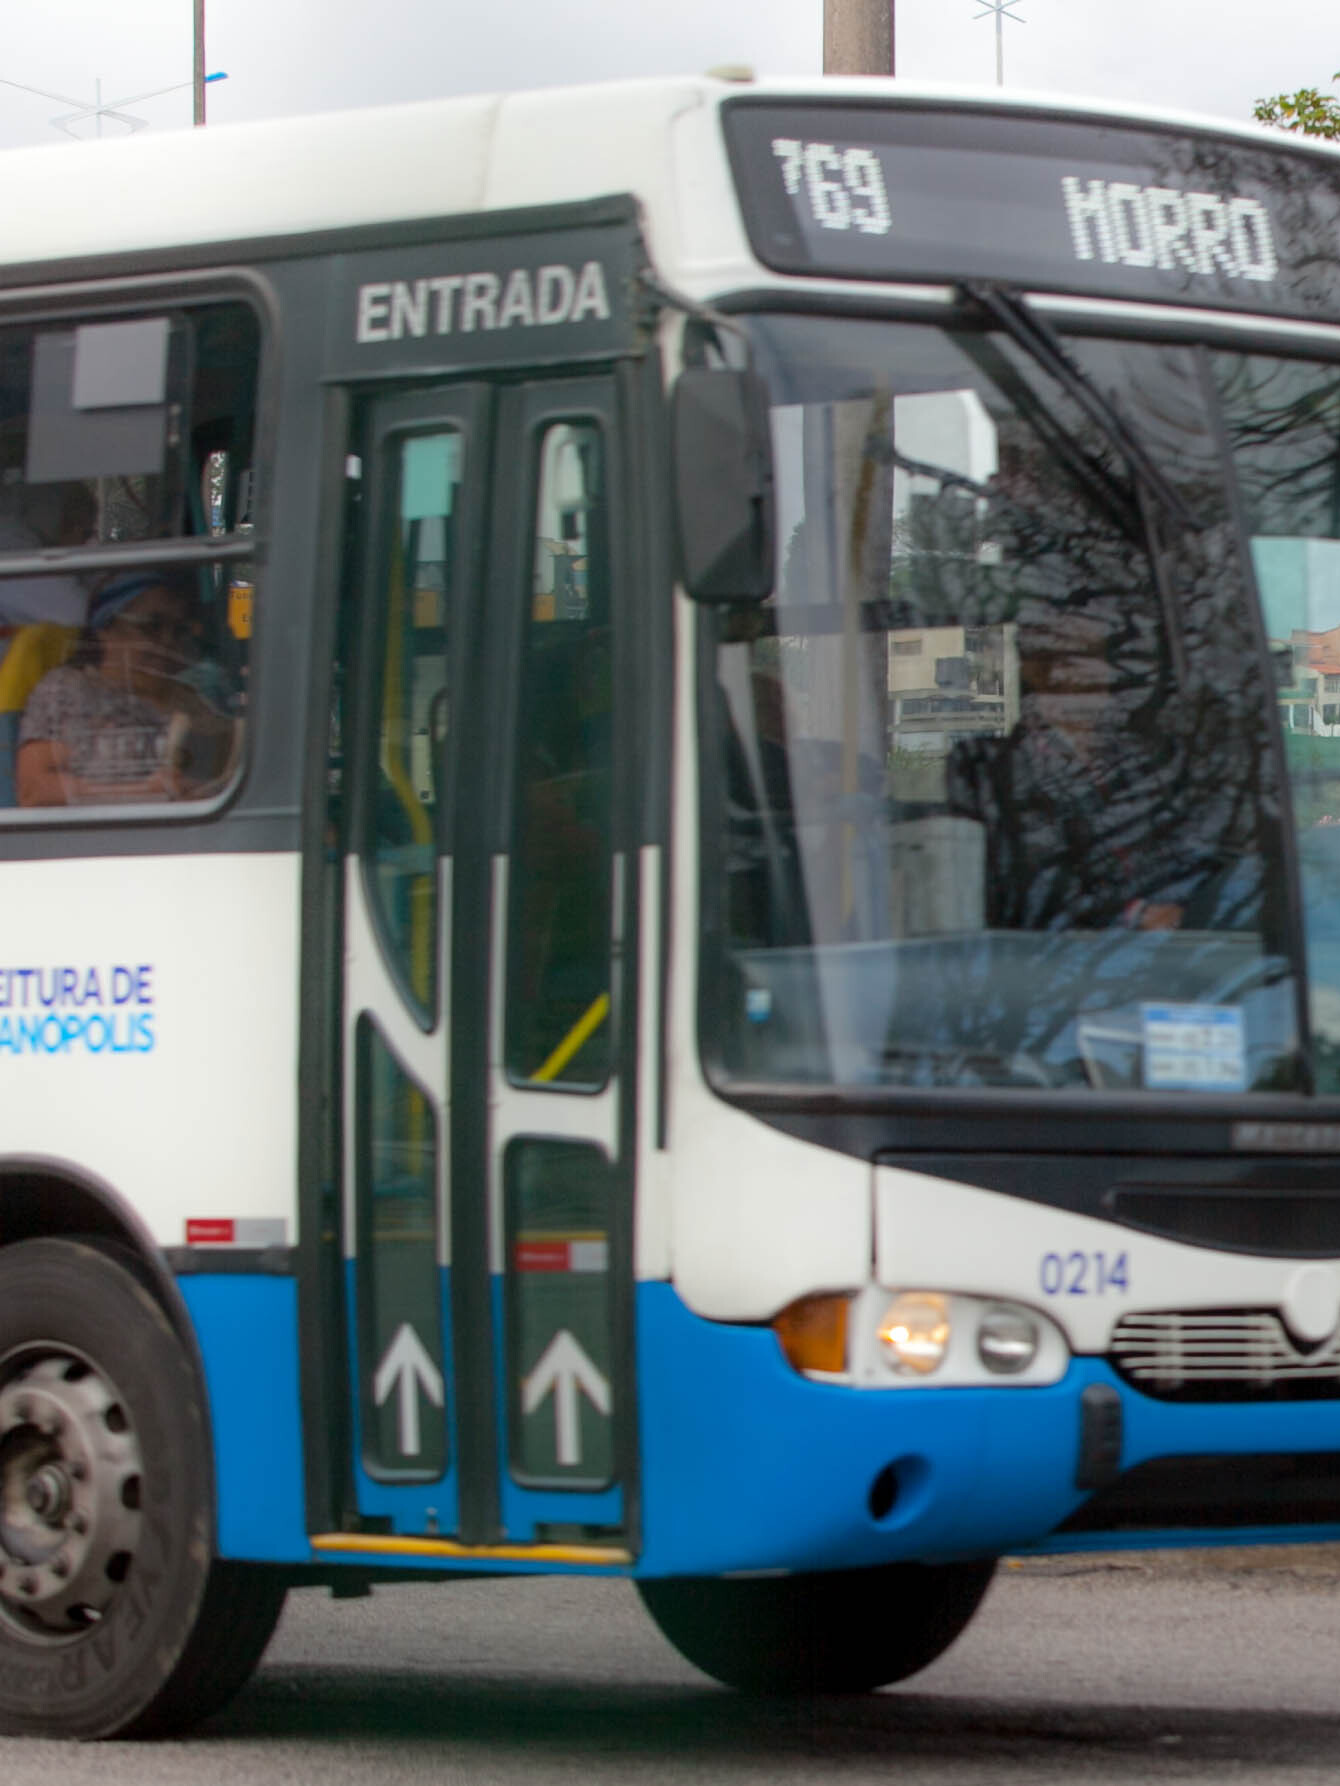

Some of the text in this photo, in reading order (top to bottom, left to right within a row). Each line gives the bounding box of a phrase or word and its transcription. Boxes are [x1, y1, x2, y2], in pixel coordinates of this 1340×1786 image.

[1062, 176, 1278, 281] MORRO
[357, 260, 610, 343] ENTRADA
[0, 962, 153, 1007] ITURA DE
[1040, 1251, 1129, 1294] 0214
